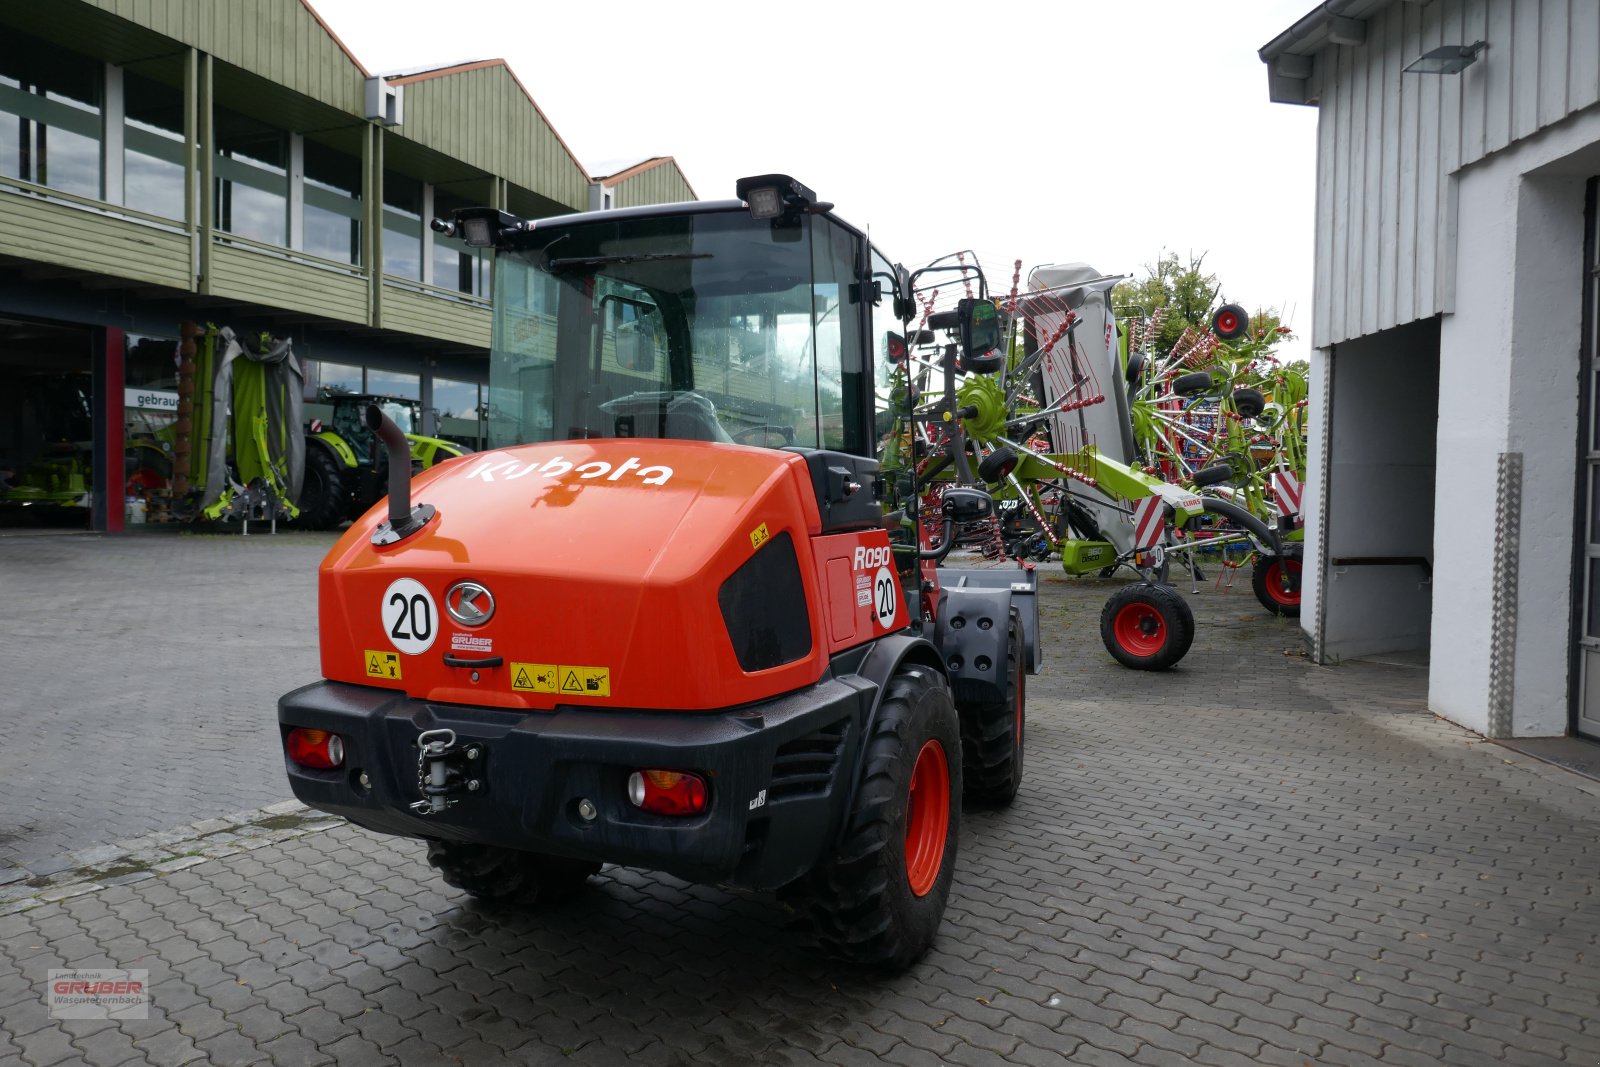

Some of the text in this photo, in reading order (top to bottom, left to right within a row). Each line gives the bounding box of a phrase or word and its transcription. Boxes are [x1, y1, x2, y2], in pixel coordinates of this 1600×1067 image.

[466, 456, 673, 485] Kubota
[1183, 499, 1201, 508] CLAAS
[877, 578, 893, 618] 20
[390, 592, 432, 641] 20
[451, 636, 493, 646] GRUBER
